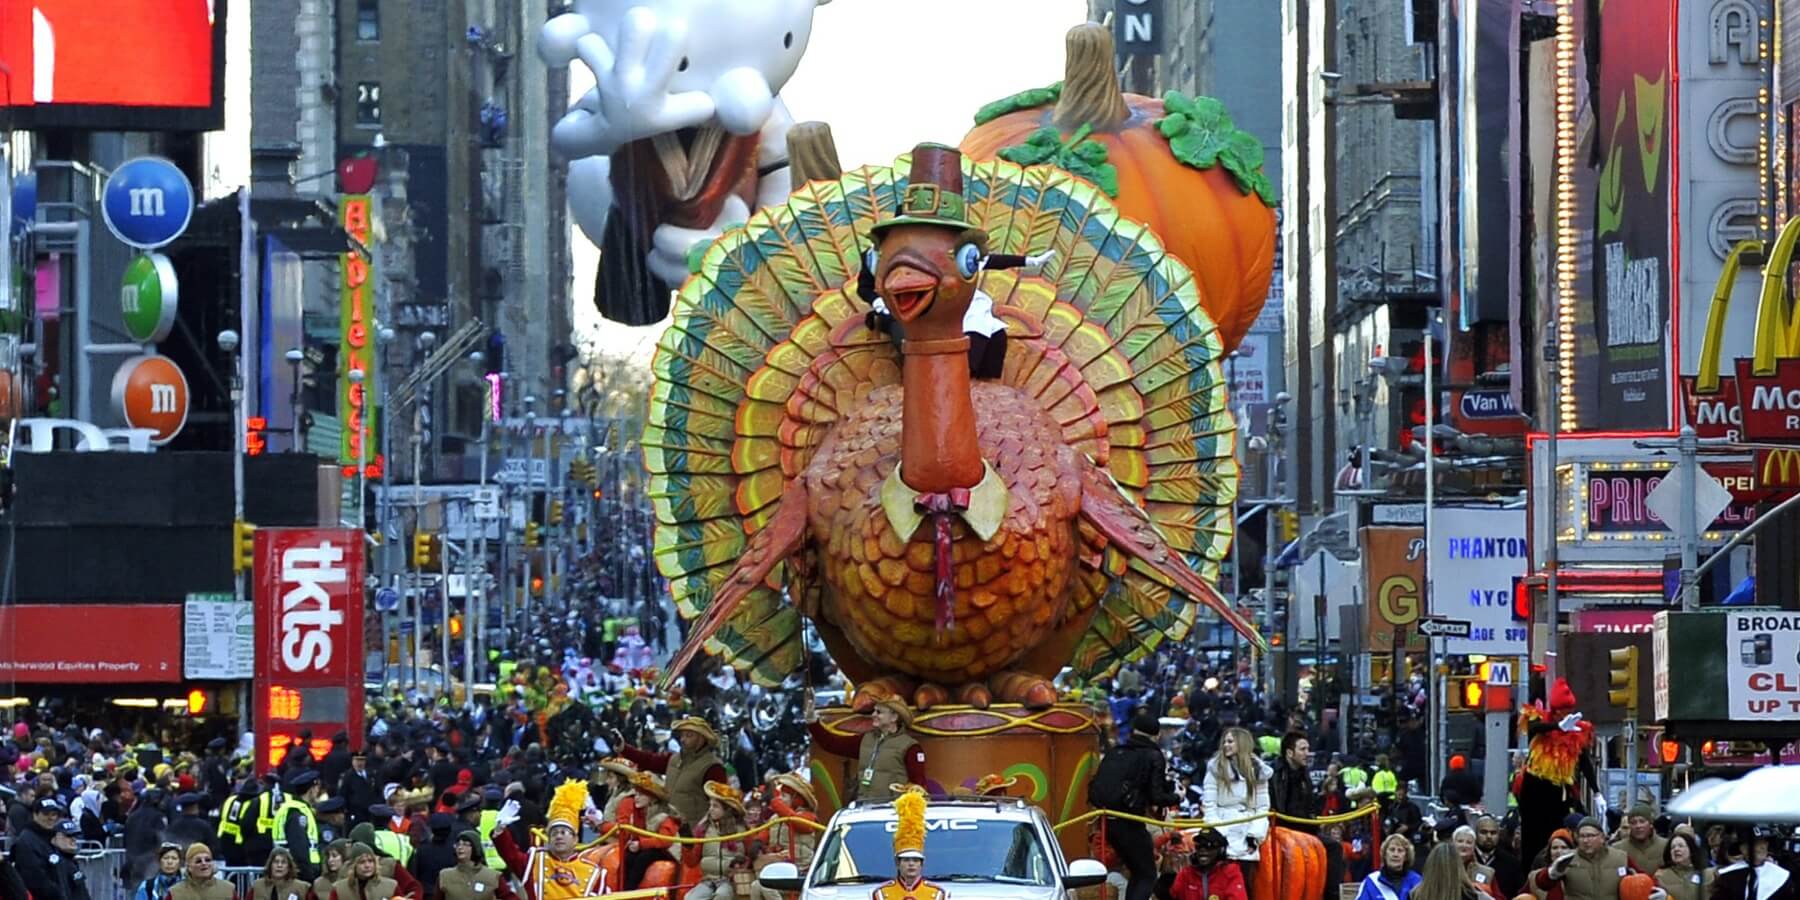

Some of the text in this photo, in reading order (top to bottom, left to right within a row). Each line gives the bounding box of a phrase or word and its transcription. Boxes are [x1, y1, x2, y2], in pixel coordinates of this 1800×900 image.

[130, 187, 165, 216] m
[121, 284, 139, 312] m
[151, 383, 176, 413] m
[1471, 395, 1497, 410] Van
[282, 541, 346, 672] tkts
[1379, 576, 1419, 625] G
[1469, 588, 1508, 607] NYC
[98, 661, 140, 672] Property
[1748, 700, 1781, 713] UP
